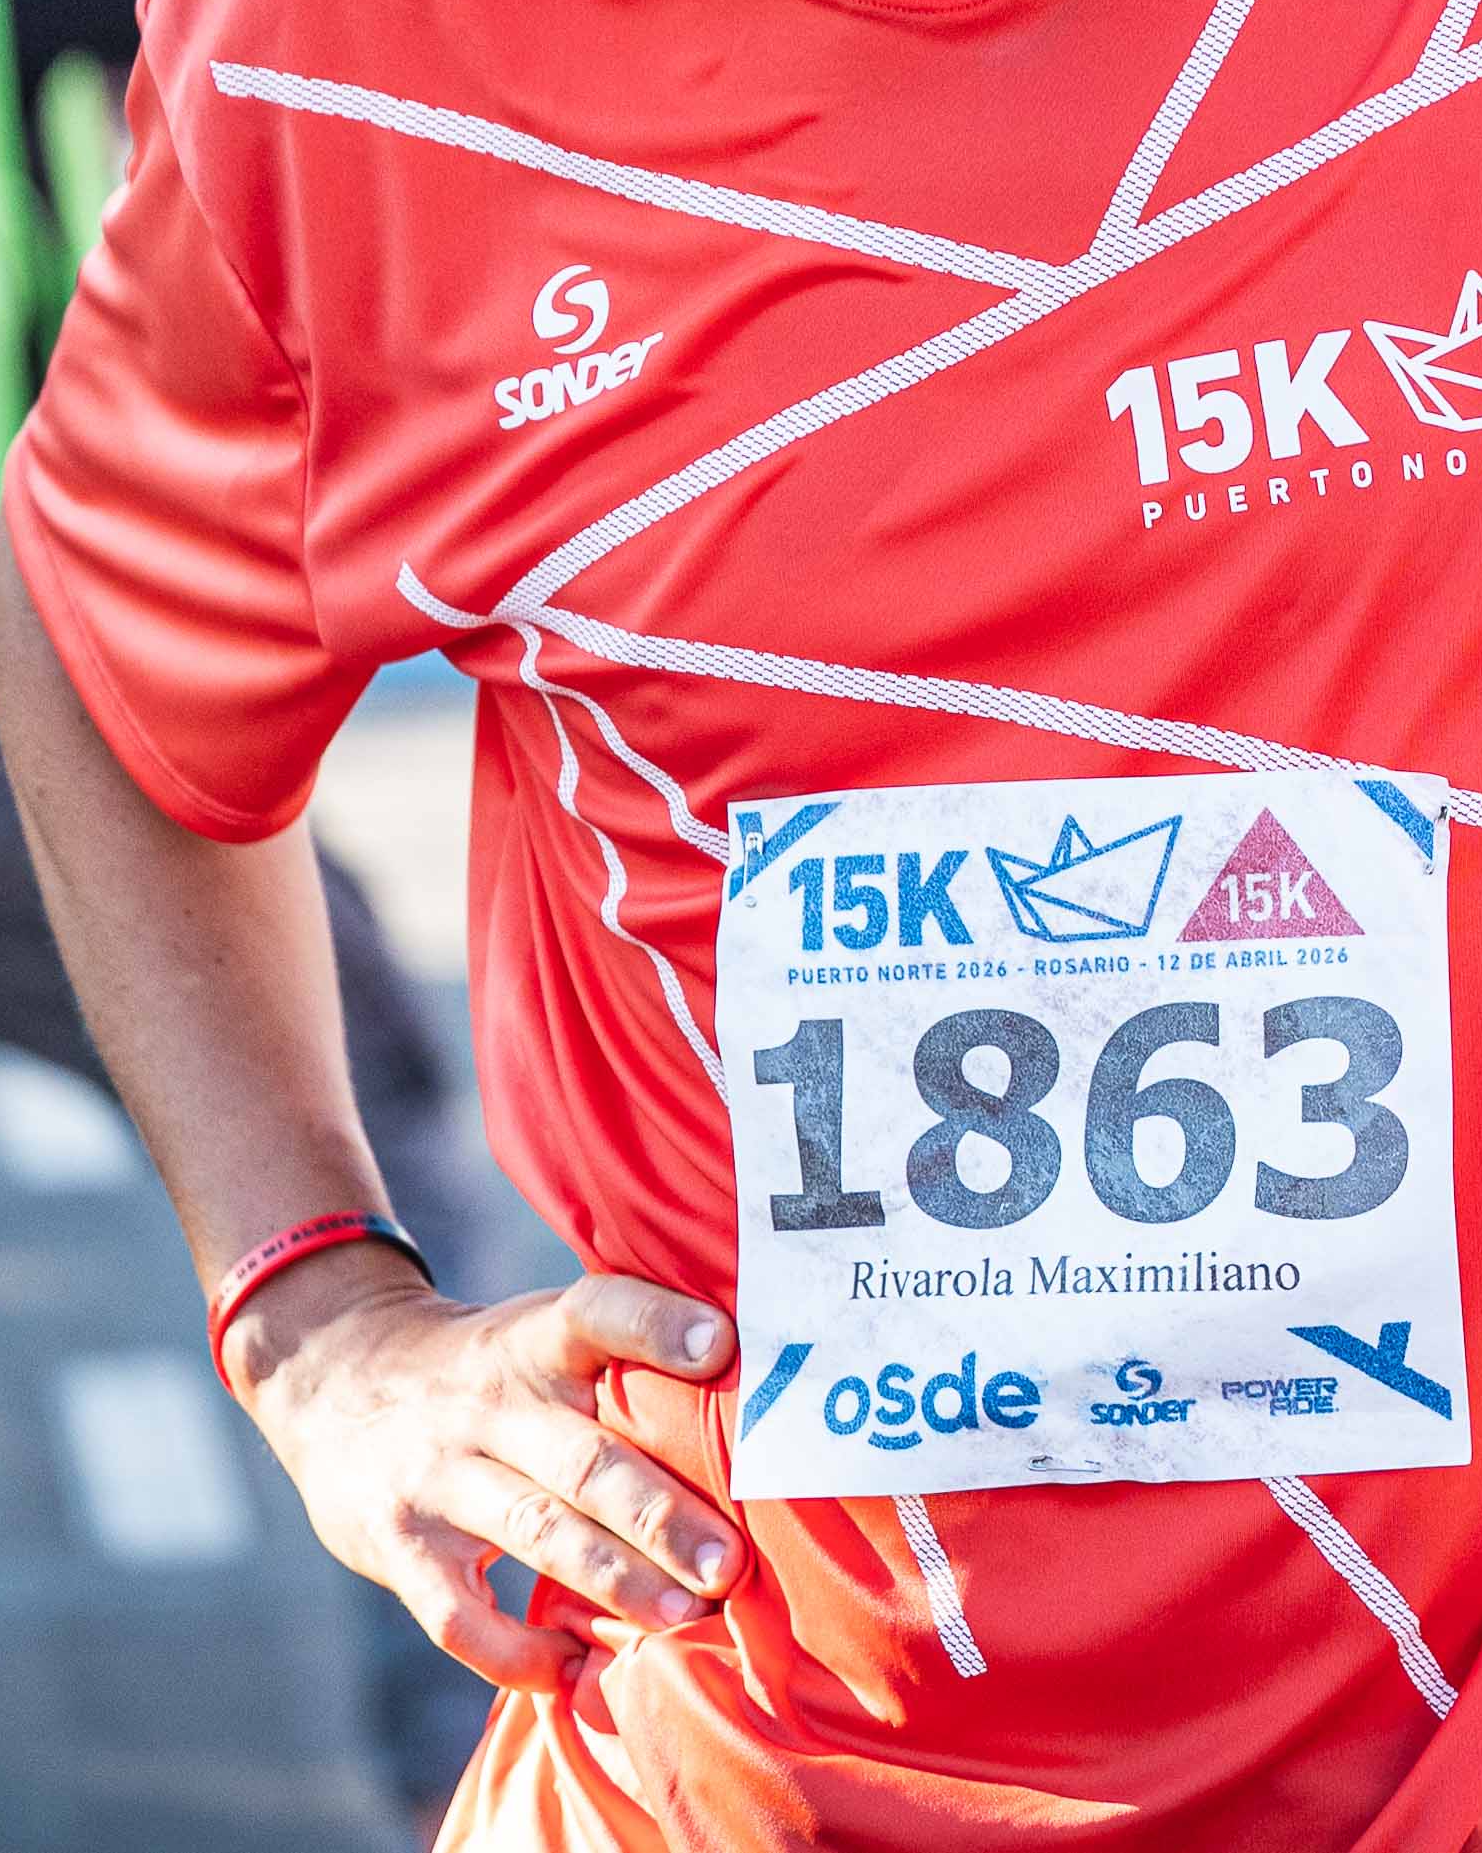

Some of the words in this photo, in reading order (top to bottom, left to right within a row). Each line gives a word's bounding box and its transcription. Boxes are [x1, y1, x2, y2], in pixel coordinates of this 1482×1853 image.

[1105, 329, 1371, 486] 15K
[1141, 460, 1374, 529] PUERTO
[788, 849, 976, 952] 15K
[1219, 870, 1319, 925] 15K
[788, 965, 869, 986] PUERTO
[877, 962, 948, 982] NORTE
[956, 959, 1008, 979] 2026
[1033, 955, 1130, 977] ROSARIO
[1157, 953, 1181, 972] 12
[1189, 951, 1217, 971] DE
[1225, 949, 1288, 969] ABRIL
[1296, 947, 1349, 965] 2026
[754, 997, 1410, 1233] 1863
[850, 1258, 1015, 1301] Rivarola
[1029, 1251, 1302, 1297] Maximiliano
[824, 1351, 1043, 1440] osde
[1220, 1376, 1339, 1399] POWER
